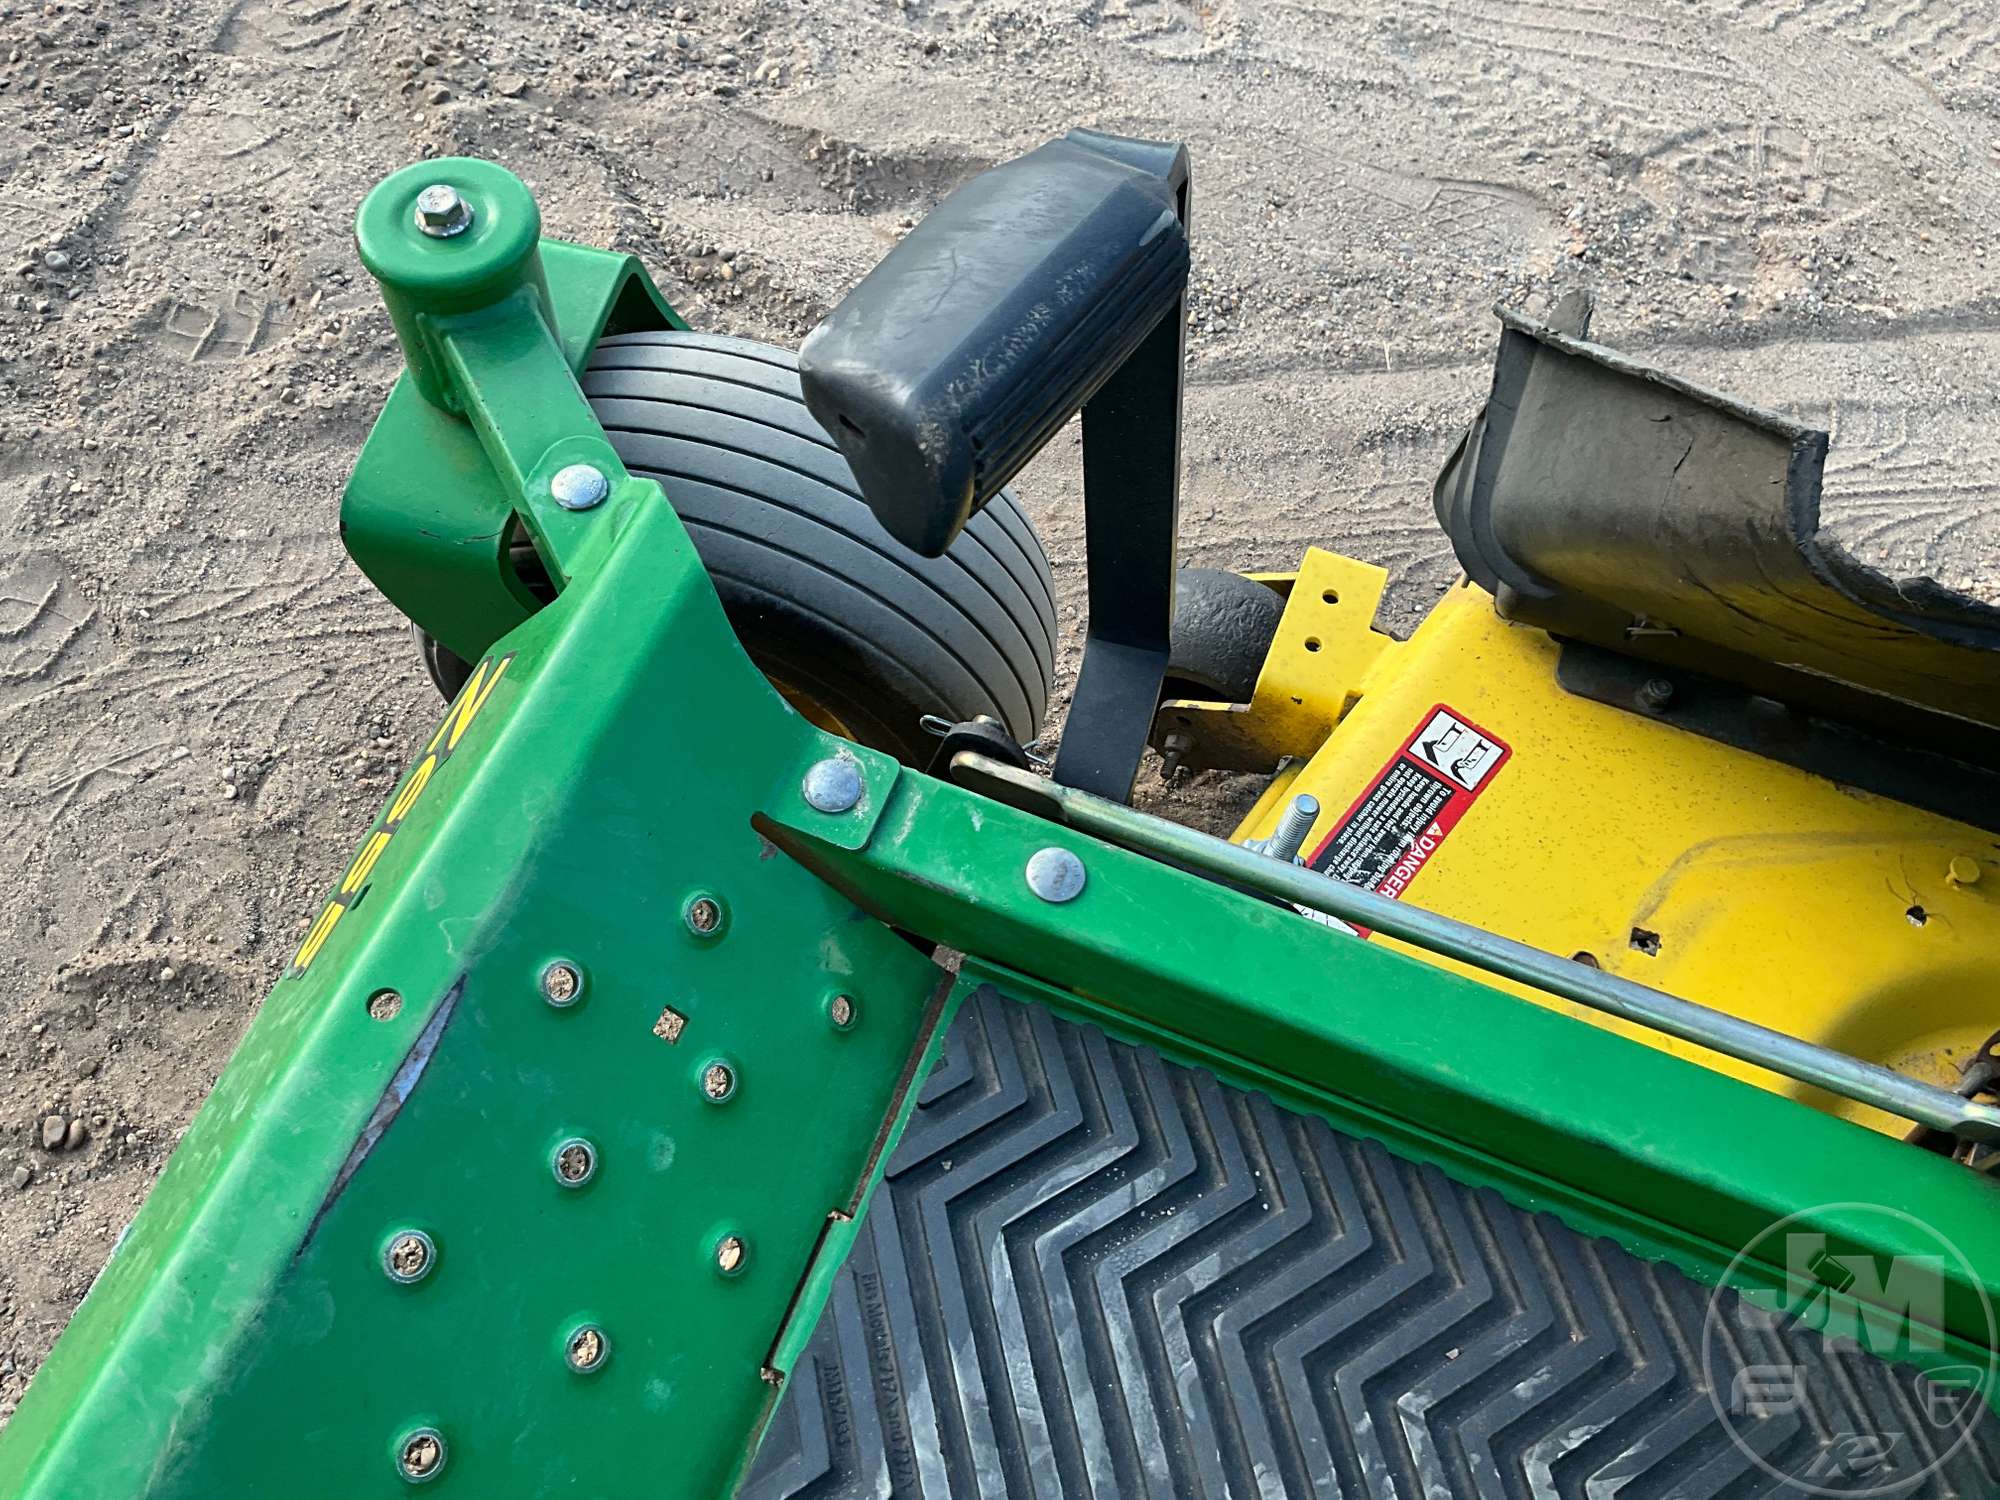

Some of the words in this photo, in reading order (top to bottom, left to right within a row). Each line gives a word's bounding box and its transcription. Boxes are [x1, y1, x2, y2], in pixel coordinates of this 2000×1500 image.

[1397, 762, 1406, 770] or
[1402, 767, 1413, 778] not
[1384, 769, 1401, 787] entire
[1384, 776, 1406, 798] operate
[1405, 772, 1422, 787] Keep
[1413, 776, 1429, 792] Keep
[1371, 784, 1387, 801] grass
[1400, 791, 1418, 808] hands
[1419, 780, 1442, 803] thrown
[1438, 787, 1452, 797] To
[294, 655, 511, 968] Z655
[1355, 800, 1375, 822] catcher
[1370, 797, 1389, 817] mower
[1391, 806, 1404, 820] and
[1424, 795, 1443, 815] avoid
[1349, 820, 1359, 828] in
[1383, 817, 1396, 830] feet
[1398, 802, 1424, 829] objects:
[1409, 812, 1430, 832] injury
[1353, 815, 1374, 838] without
[1368, 819, 1382, 833] safe
[1335, 826, 1354, 845] place.
[1369, 828, 1386, 845] away
[1330, 836, 1358, 865] discharge
[1379, 835, 1435, 899] DANGER
